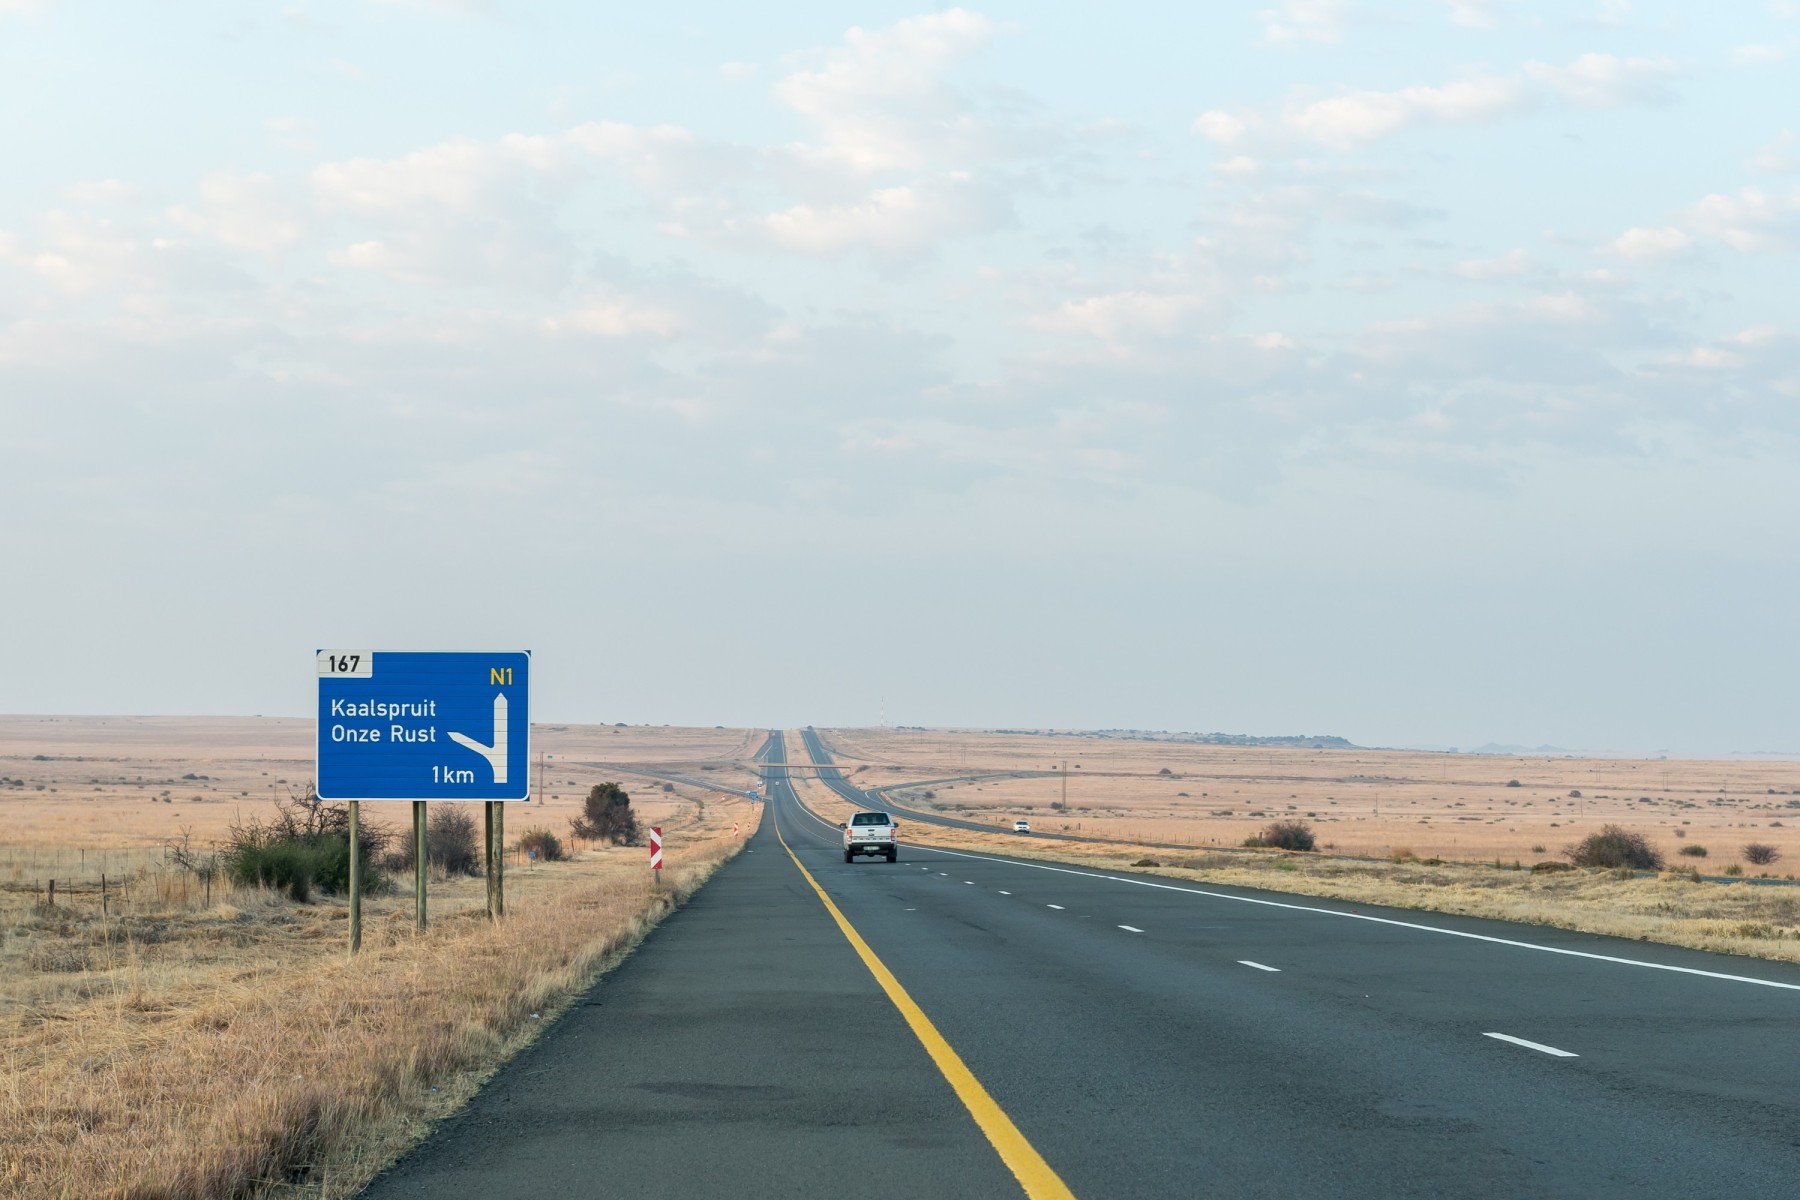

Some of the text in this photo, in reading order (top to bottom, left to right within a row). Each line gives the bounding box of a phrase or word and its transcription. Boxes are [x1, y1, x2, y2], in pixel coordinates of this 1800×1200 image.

[329, 655, 360, 673] 167
[490, 667, 513, 686] N1
[331, 698, 436, 721] Kaalspruit
[331, 724, 436, 742] Onze Rust
